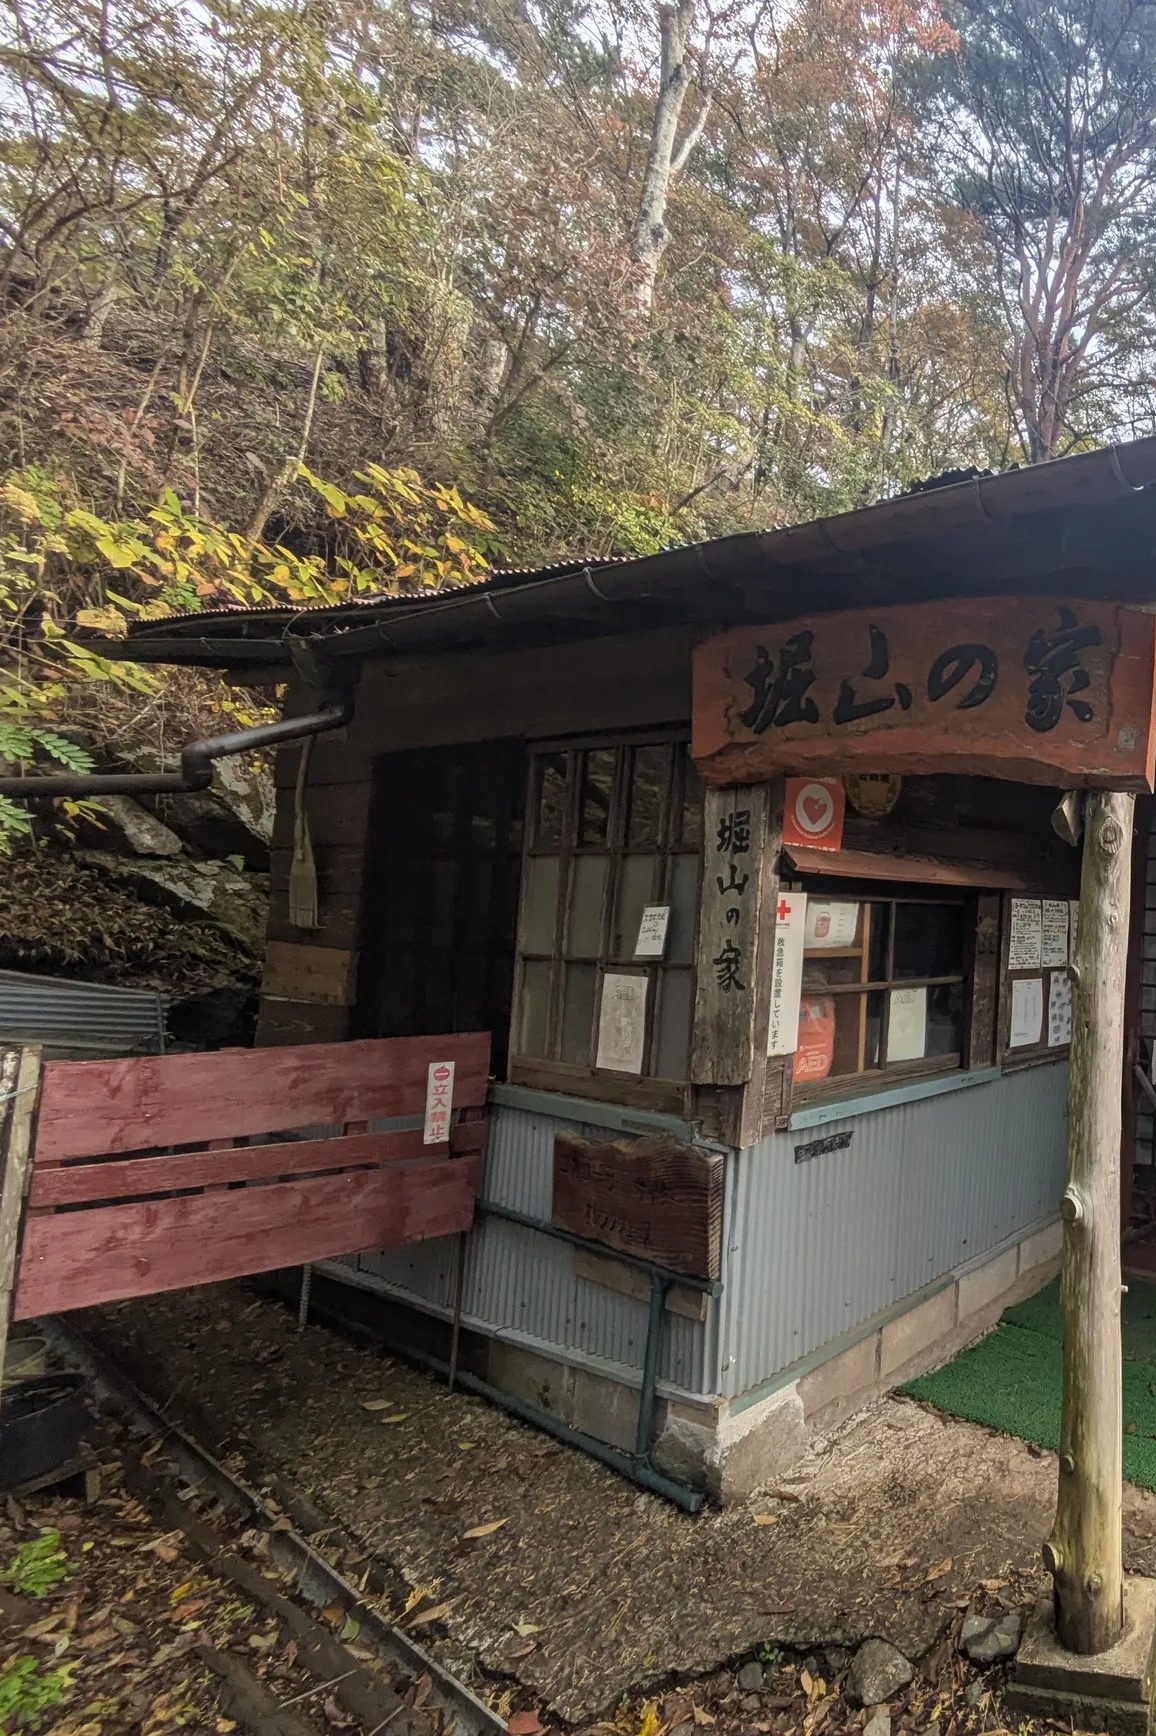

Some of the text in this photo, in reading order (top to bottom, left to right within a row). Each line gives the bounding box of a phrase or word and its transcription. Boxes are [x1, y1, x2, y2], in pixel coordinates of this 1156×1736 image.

[740, 605, 1104, 733] 堀山の家
[713, 810, 751, 994] 堀山の家
[771, 937, 786, 1050] 救急箱を設置しています
[893, 991, 917, 1005] AED
[796, 1054, 828, 1074] AED
[428, 1084, 449, 1137] 立入禁止
